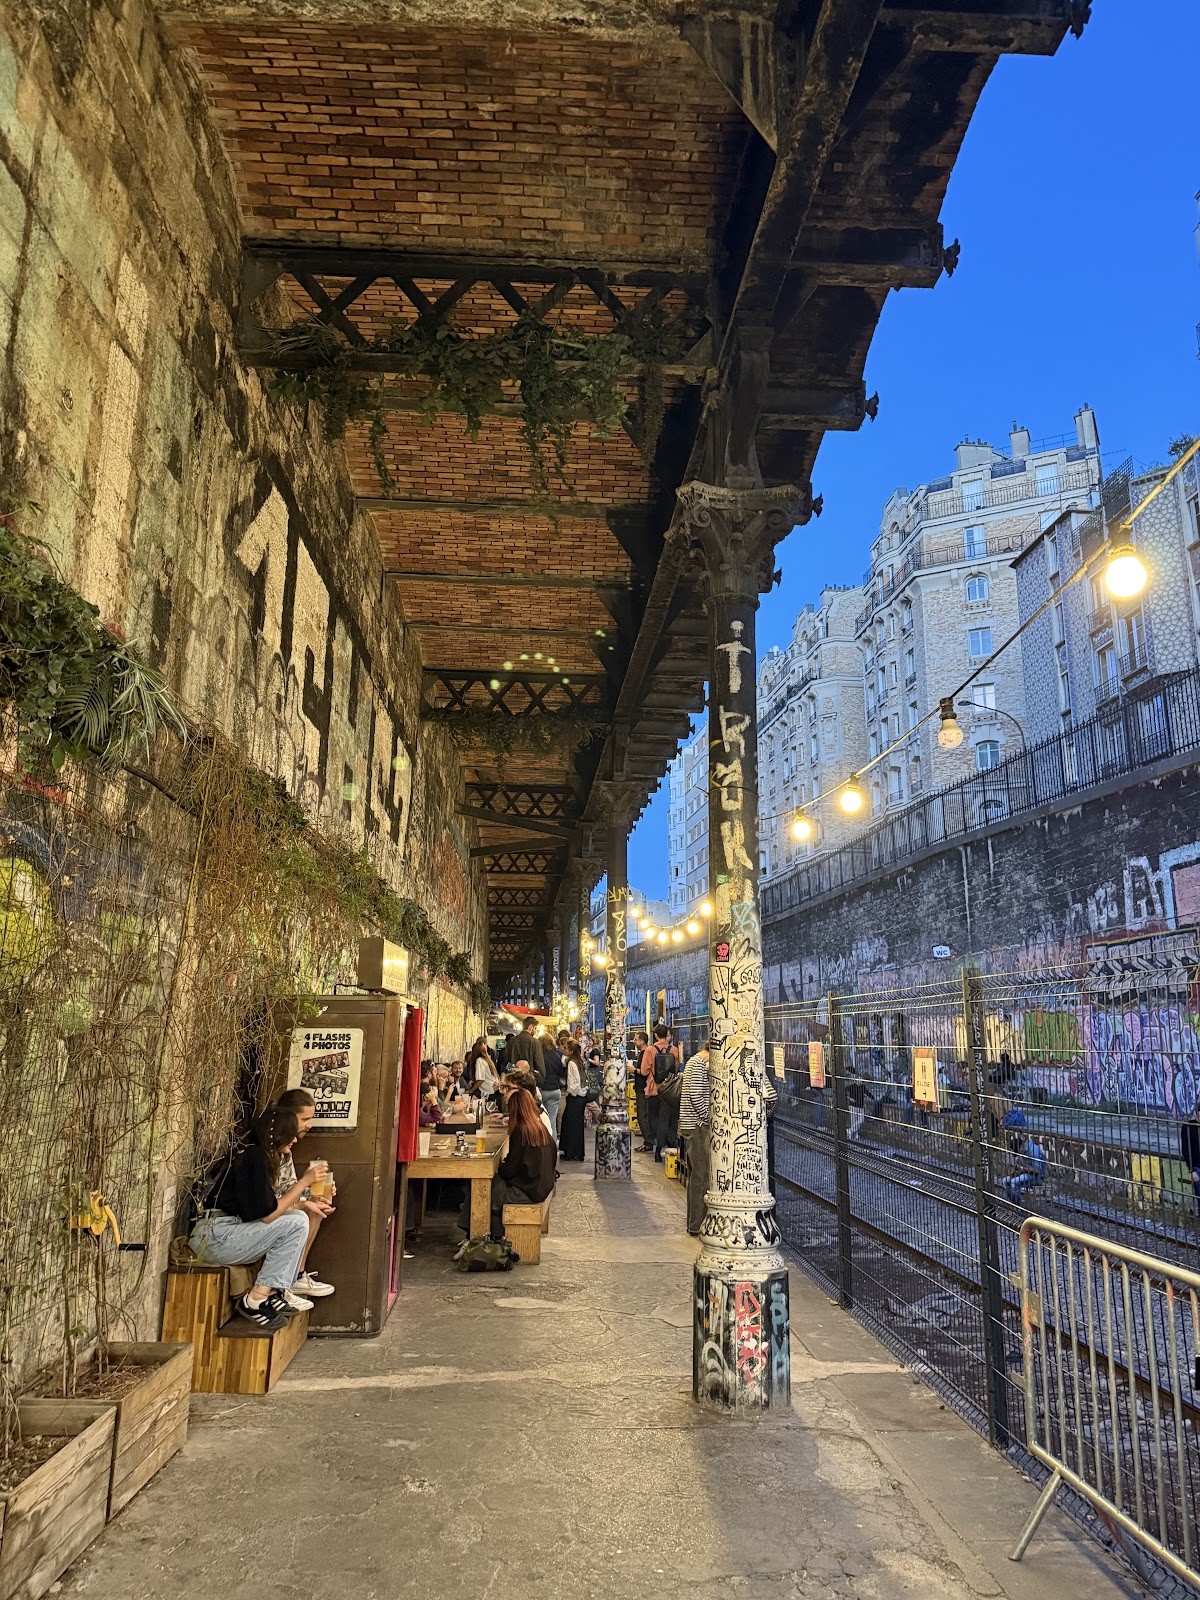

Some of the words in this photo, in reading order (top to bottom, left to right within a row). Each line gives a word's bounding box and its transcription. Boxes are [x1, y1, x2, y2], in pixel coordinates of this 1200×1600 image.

[304, 1033, 311, 1041] 4
[312, 1033, 352, 1042] FLASHS
[303, 1041, 310, 1050] 4
[311, 1041, 351, 1050] PHOTOS
